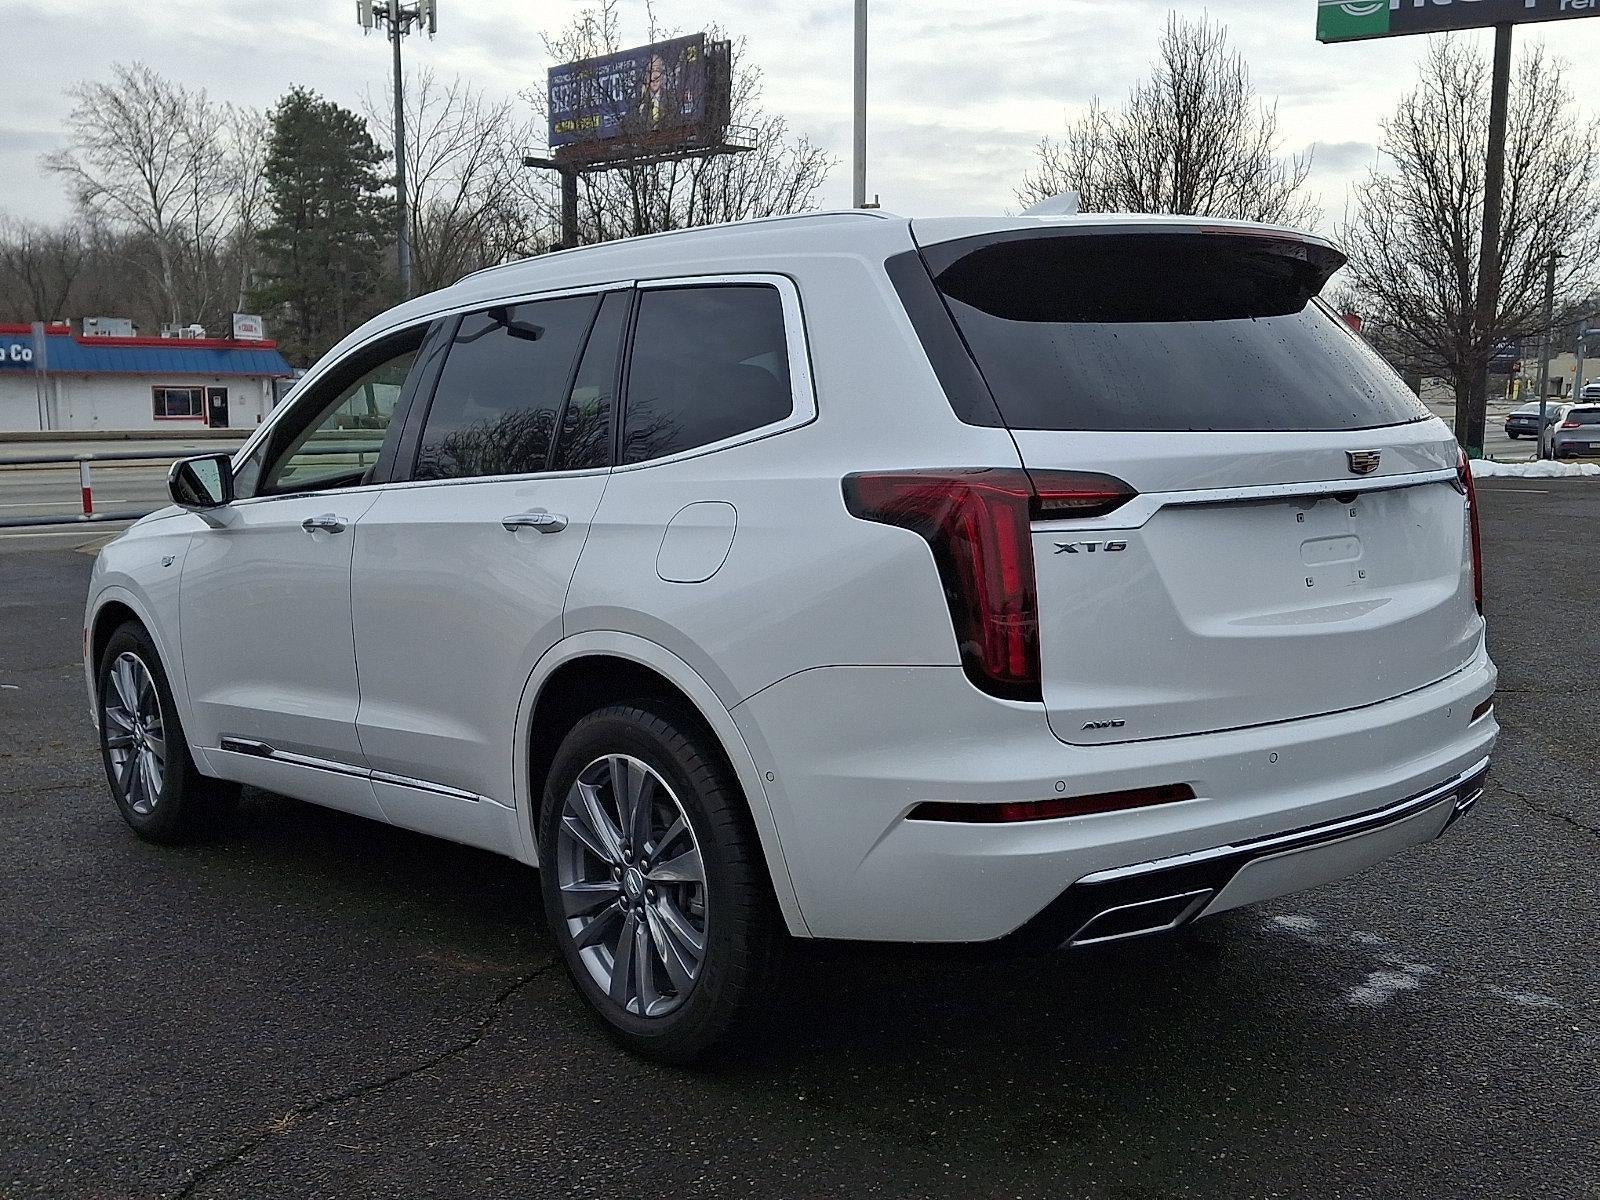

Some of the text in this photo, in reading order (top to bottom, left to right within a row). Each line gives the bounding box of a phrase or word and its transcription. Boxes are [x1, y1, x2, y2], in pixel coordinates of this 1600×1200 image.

[10, 344, 32, 361] Co
[1053, 539, 1128, 554] XT6
[1080, 719, 1126, 730] AWD
